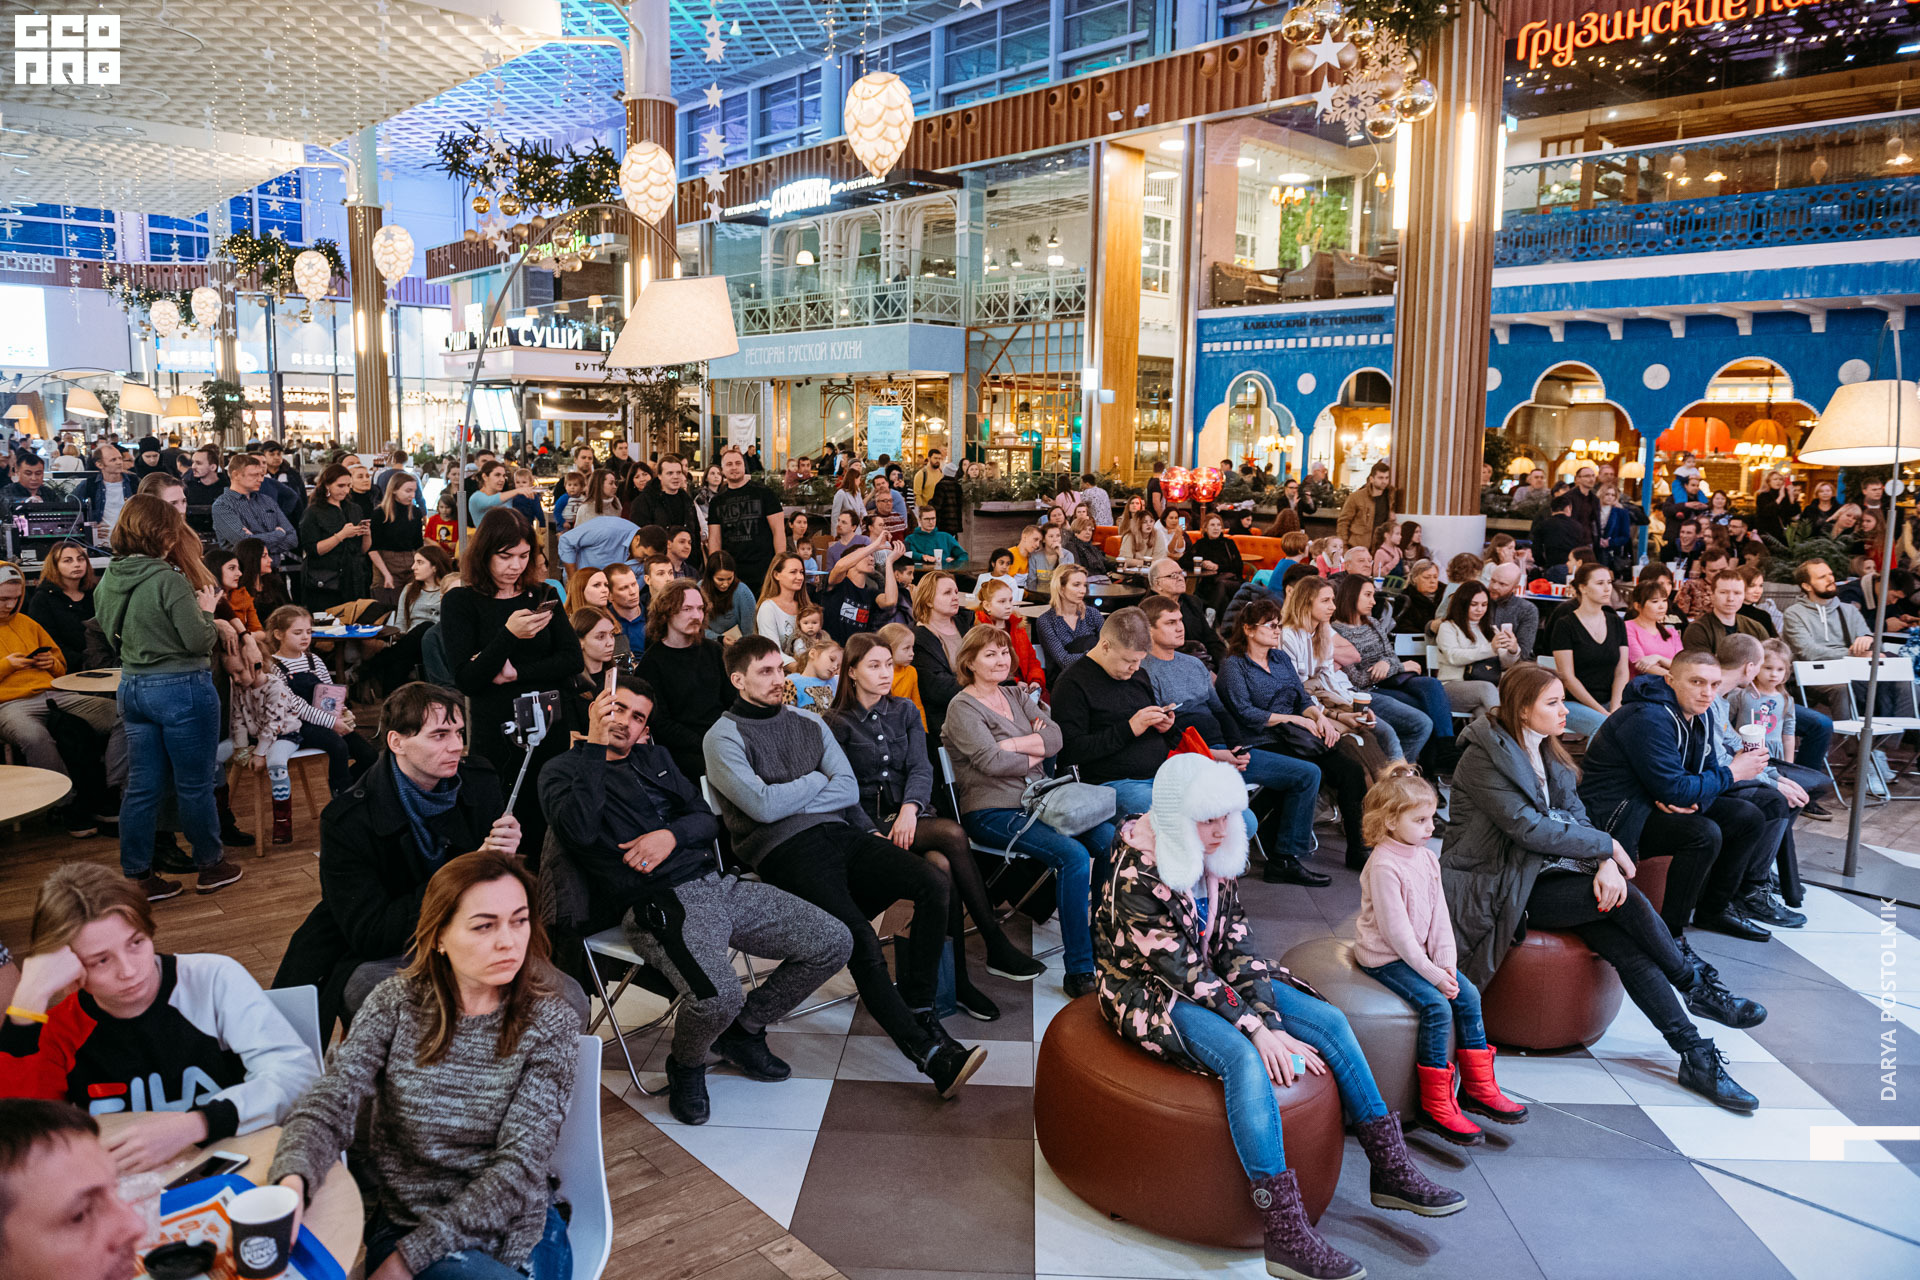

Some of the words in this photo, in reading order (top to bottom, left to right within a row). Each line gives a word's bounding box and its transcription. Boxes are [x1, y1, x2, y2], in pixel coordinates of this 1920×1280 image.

[1516, 0, 1747, 70] Грузинские
[1243, 317, 1307, 330] КАВКАЗСКИЙ
[1309, 313, 1385, 327] РЕСТОРАНЧИК
[518, 325, 583, 350] СУШИ
[745, 346, 785, 365] РЕСТОРАН
[788, 342, 828, 362] РУССКОЙ
[830, 340, 863, 361] КУХНИ
[88, 1066, 224, 1116] FILA
